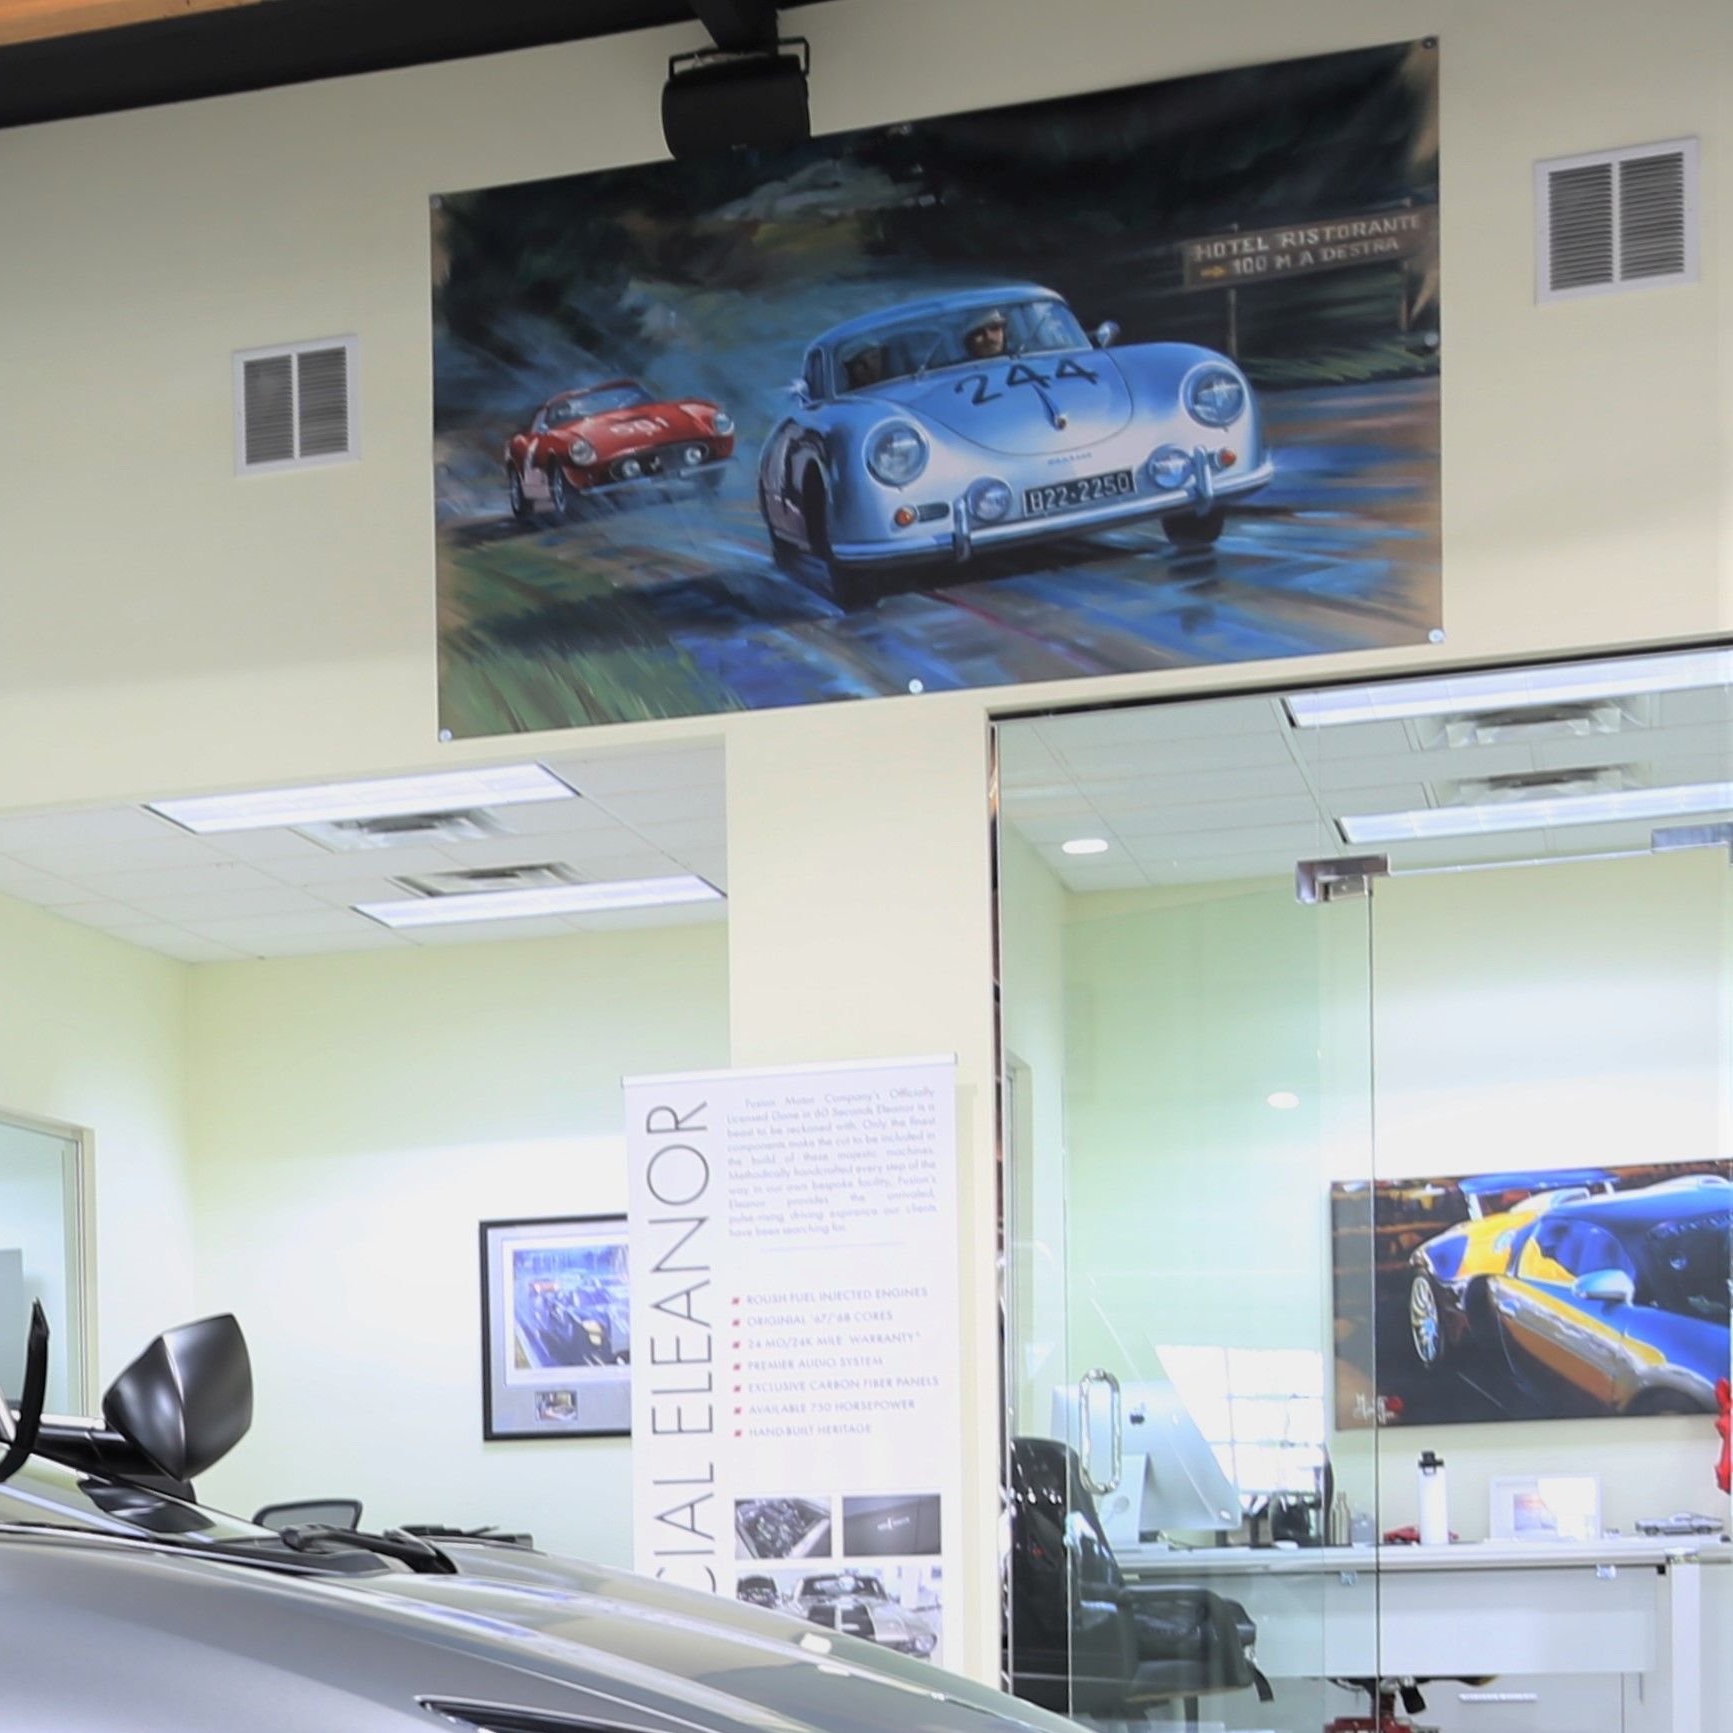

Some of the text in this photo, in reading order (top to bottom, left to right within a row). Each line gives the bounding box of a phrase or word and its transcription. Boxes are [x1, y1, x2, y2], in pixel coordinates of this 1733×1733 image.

[1194, 213, 1421, 261] HOTEL RISTORANTE
[1233, 255, 1267, 275] 100
[1300, 251, 1315, 266] A
[1321, 236, 1400, 262] DESTRA
[954, 358, 1100, 407] 244
[889, 1086, 933, 1102] Officially
[645, 1101, 715, 1435] ELEANOR
[790, 1291, 814, 1303] FUEL
[820, 1289, 871, 1301] INJECTED
[876, 1286, 928, 1299] ENGINES
[854, 1310, 893, 1322] CORES
[817, 1335, 842, 1346] MILE
[749, 1355, 883, 1371] PREMIER AUDIO SYSTEM
[749, 1375, 939, 1393] EXCLUSIVE CARBON FIBER PANELS
[749, 1403, 805, 1416] AVAILABLE
[835, 1399, 915, 1413] HORSEPOWER
[818, 1423, 870, 1435] HERITAGE
